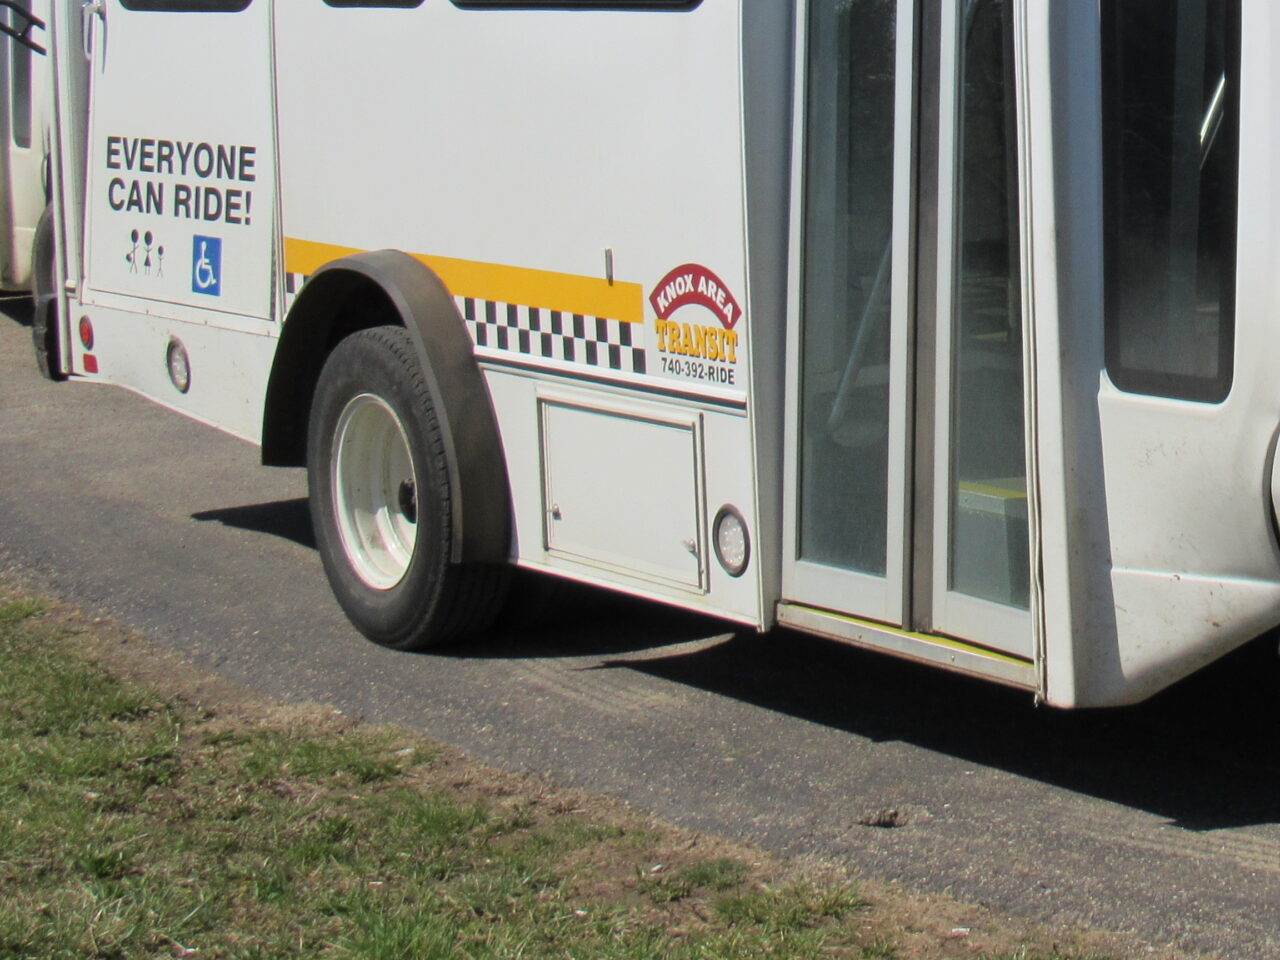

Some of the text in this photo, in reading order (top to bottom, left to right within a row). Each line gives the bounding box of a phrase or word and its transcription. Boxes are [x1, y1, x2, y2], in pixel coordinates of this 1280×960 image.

[106, 136, 257, 182] EVERYONE
[108, 177, 252, 226] CAN RIDE!
[656, 273, 734, 323] KNOX AREA
[655, 318, 738, 364] TRANSIT
[661, 357, 736, 385] 740-392-RIDE
